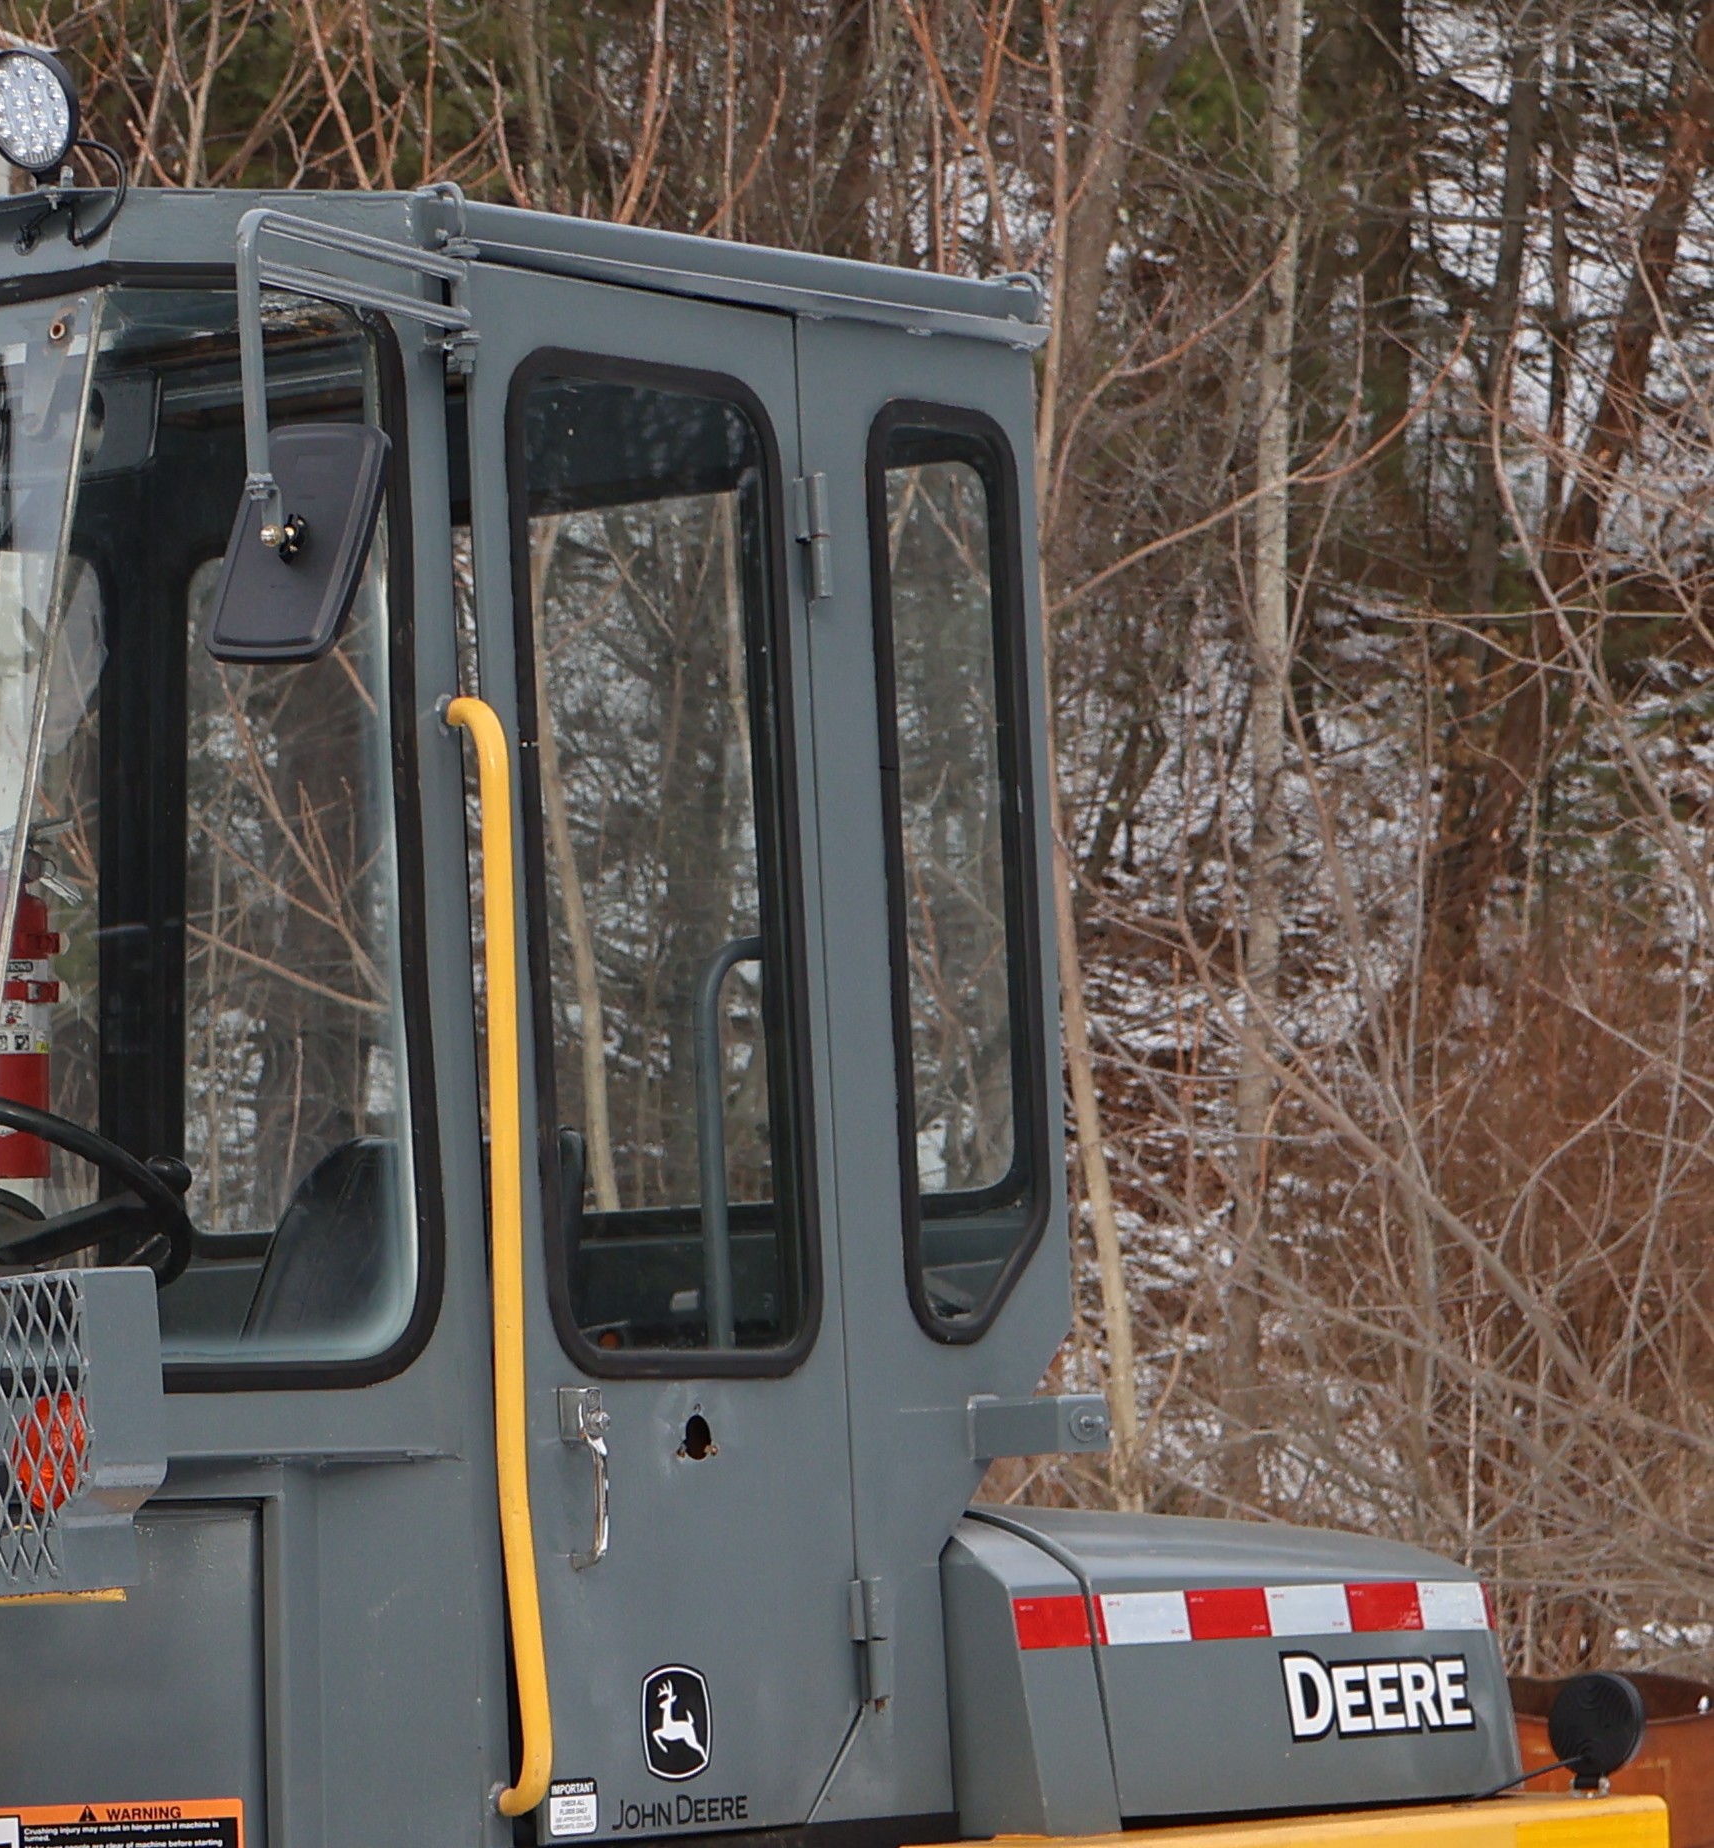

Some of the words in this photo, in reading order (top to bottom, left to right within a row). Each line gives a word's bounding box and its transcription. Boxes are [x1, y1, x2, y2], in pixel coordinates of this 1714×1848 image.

[1280, 1652, 1475, 1740] DEERE
[551, 1781, 594, 1796] IMPORTANT
[106, 1806, 182, 1821] WARNING
[611, 1799, 672, 1831] JOHN
[675, 1794, 749, 1825] DEERE
[24, 1827, 58, 1836] Crushing
[59, 1827, 81, 1835] injury
[82, 1826, 98, 1834] may
[131, 1823, 152, 1832] hinge
[178, 1821, 211, 1829] machine
[194, 1839, 223, 1847] starting
